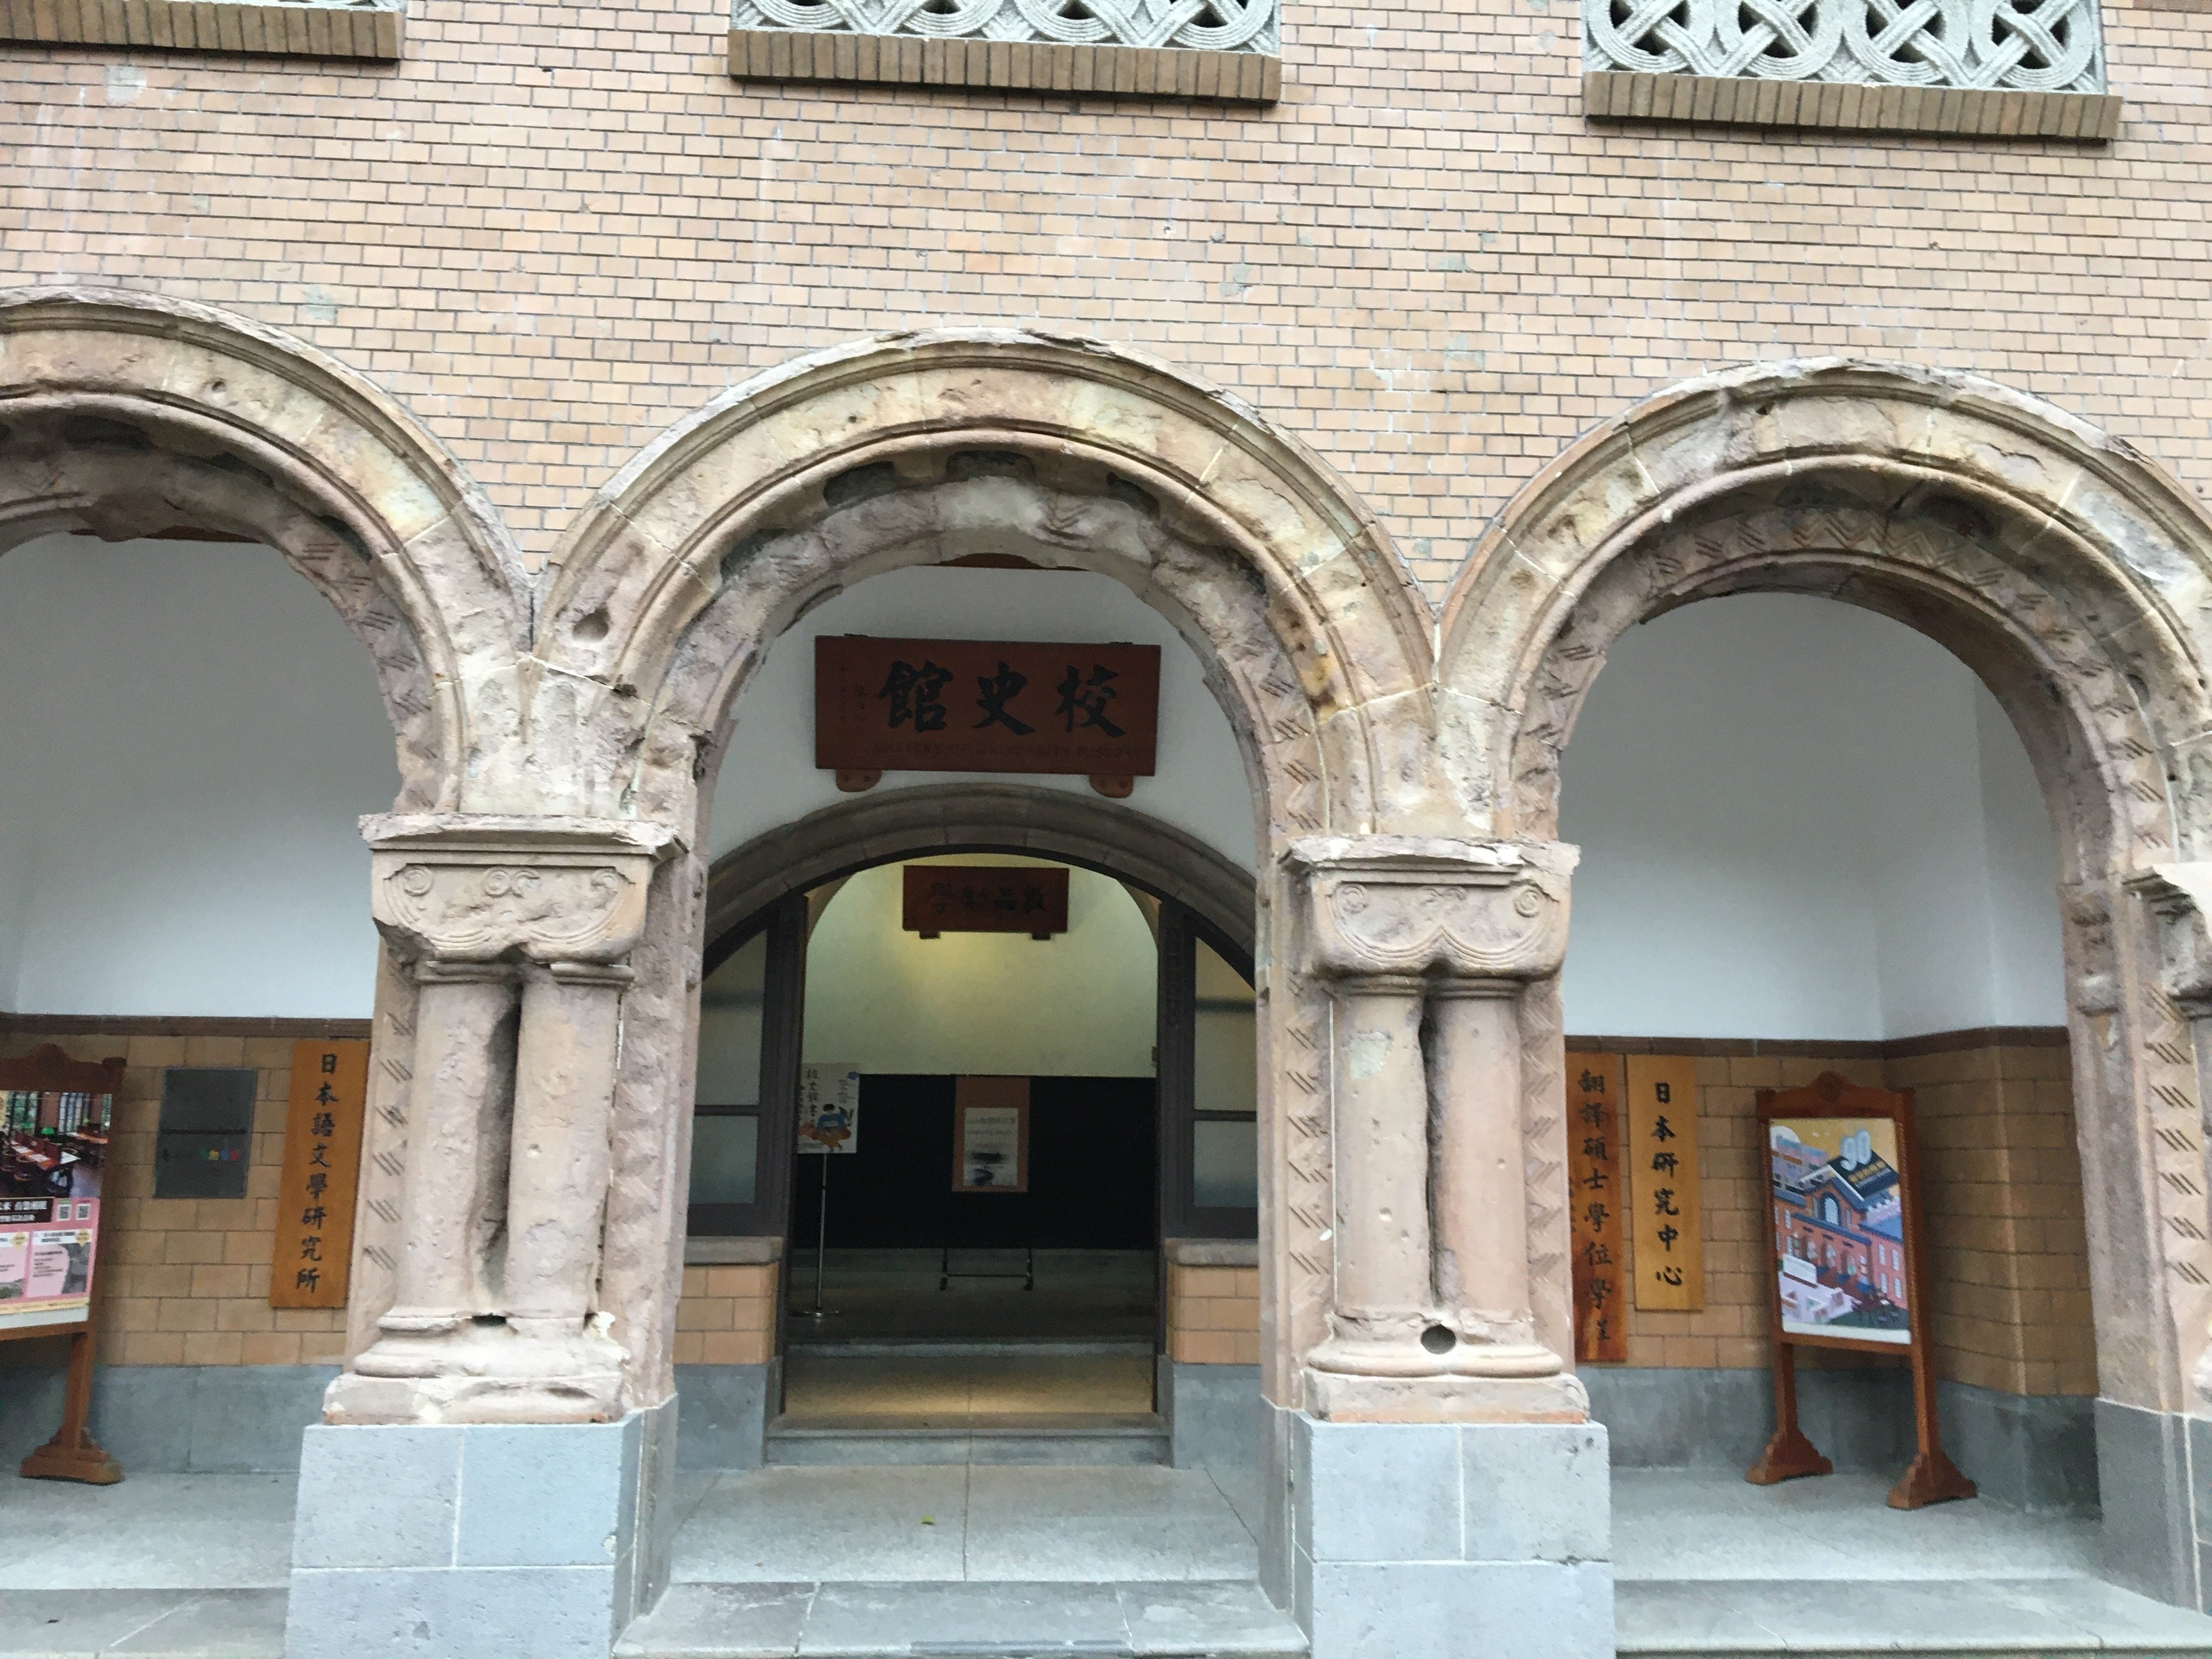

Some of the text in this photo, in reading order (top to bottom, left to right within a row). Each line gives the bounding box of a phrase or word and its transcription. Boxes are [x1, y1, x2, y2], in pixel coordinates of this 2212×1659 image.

[878, 660, 1126, 738] 校史館
[295, 1053, 339, 1293] 日本語文學研究所
[1651, 1081, 1683, 1286] 日本研究中心
